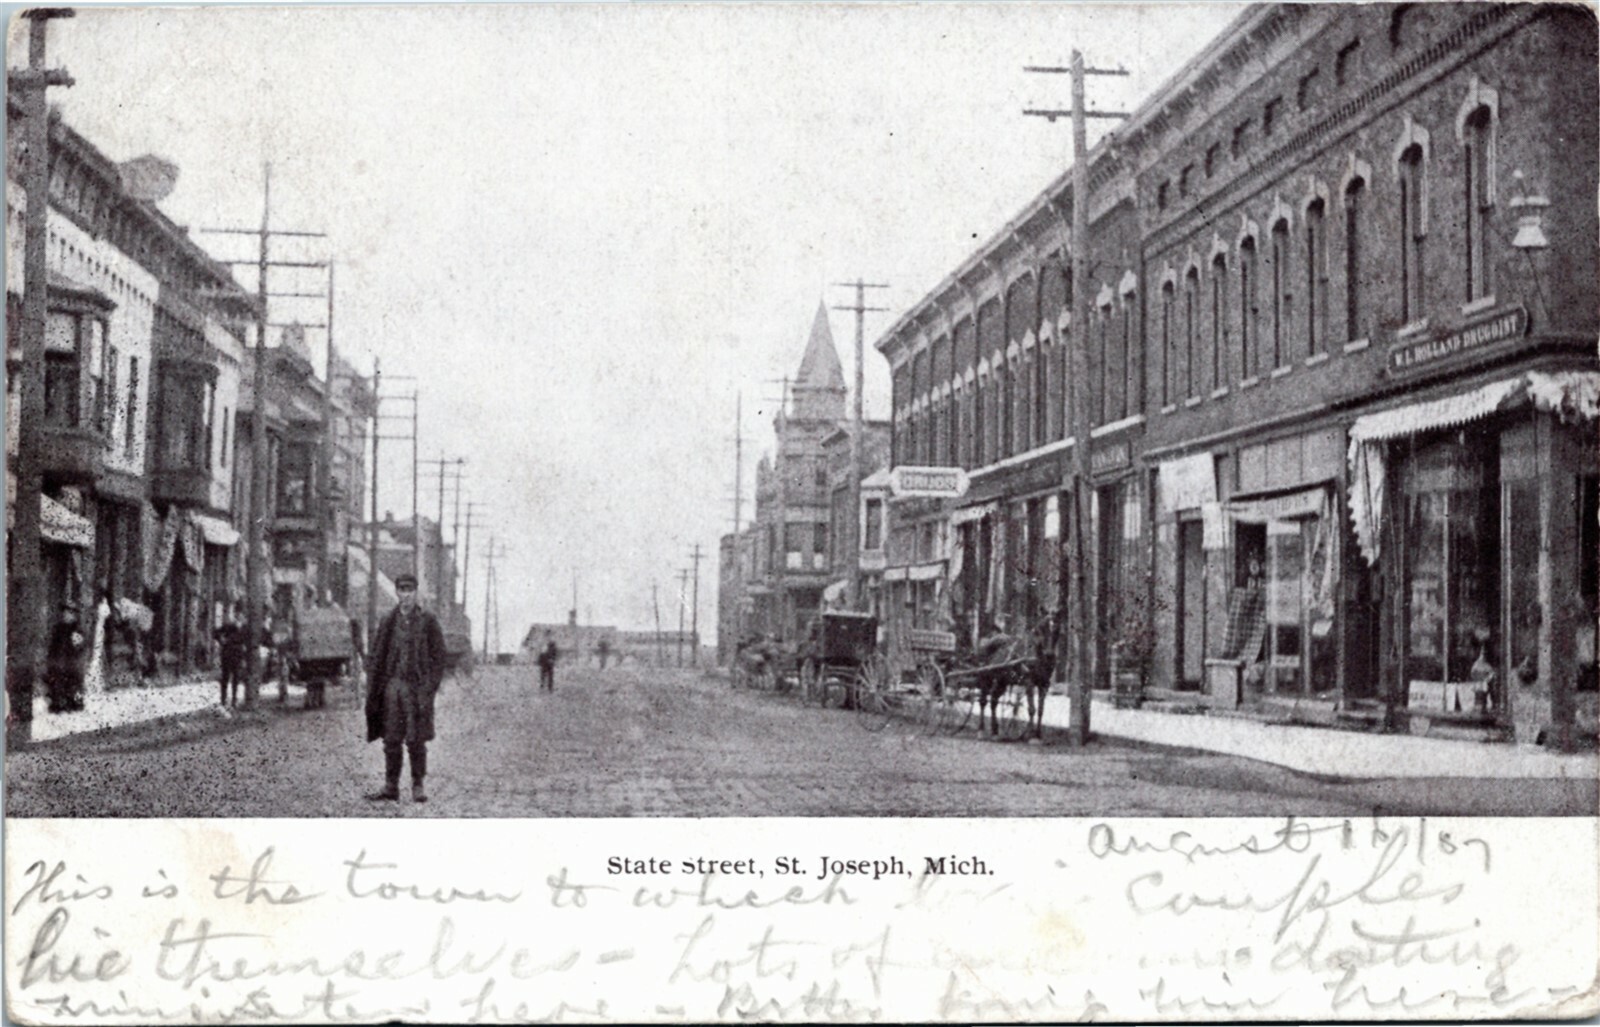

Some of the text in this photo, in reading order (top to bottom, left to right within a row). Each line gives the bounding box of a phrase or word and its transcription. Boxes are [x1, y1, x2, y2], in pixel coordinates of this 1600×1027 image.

[12, 860, 113, 916] This
[142, 869, 179, 899] is
[209, 846, 327, 904] the
[343, 848, 522, 904] town
[546, 866, 621, 908] to
